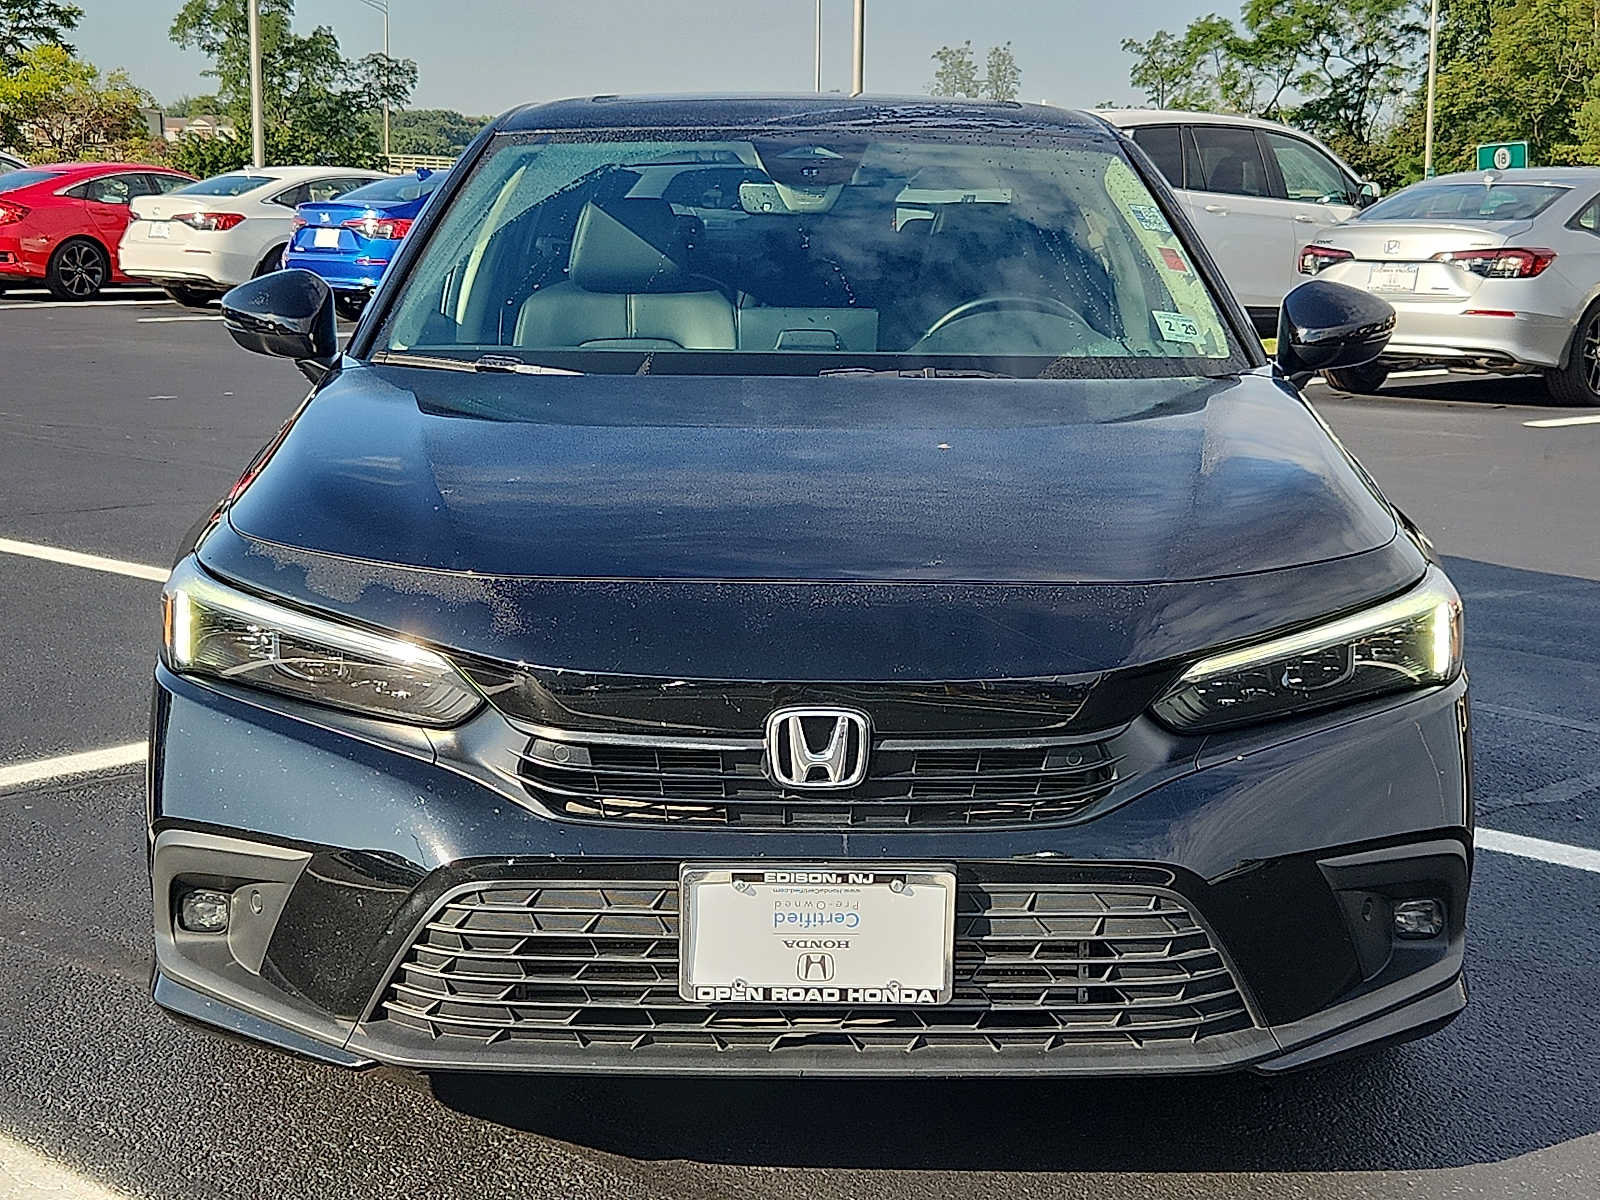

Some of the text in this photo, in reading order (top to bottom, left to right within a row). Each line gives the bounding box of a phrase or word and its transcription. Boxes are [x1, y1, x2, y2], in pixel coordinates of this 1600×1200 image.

[764, 872, 875, 884] EDISON, NJ
[774, 900, 859, 911] Pre-Owned
[773, 912, 860, 929] Certified
[783, 940, 850, 949] HONDA
[697, 987, 935, 1003] OPEN ROAD HONDA
